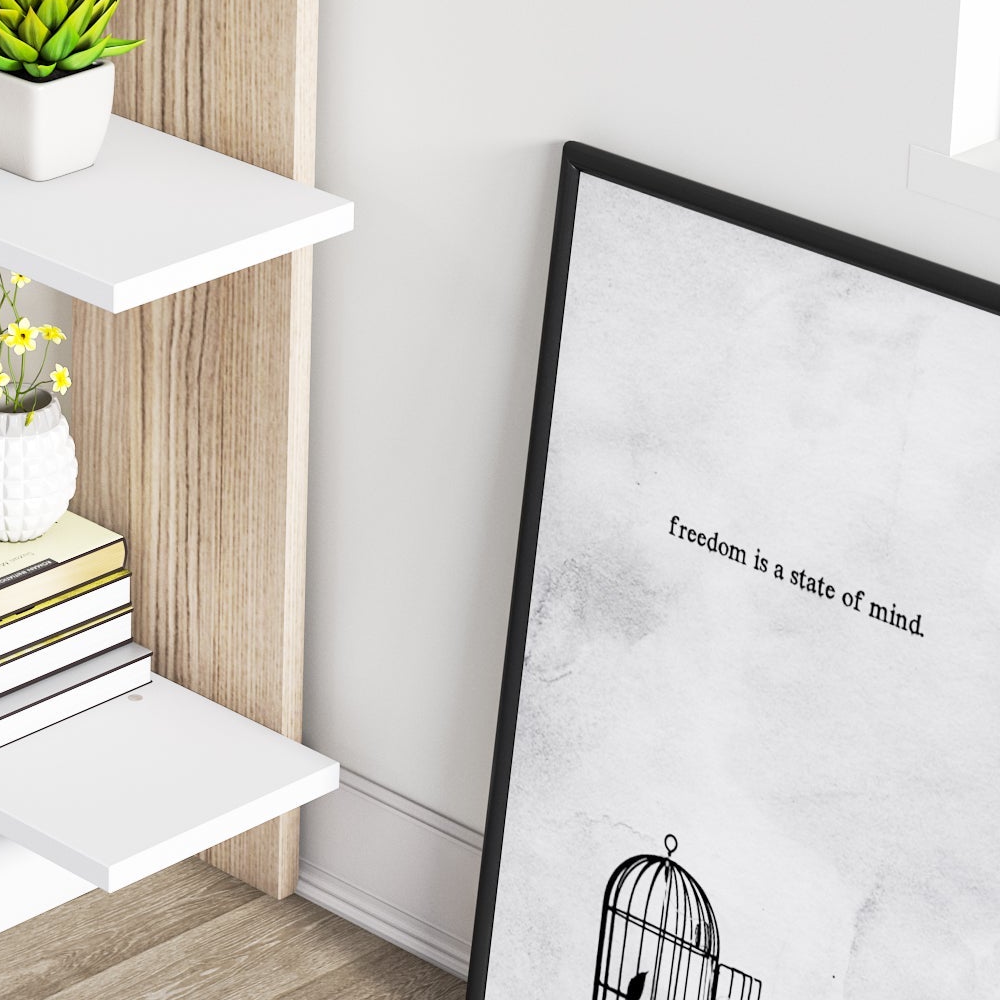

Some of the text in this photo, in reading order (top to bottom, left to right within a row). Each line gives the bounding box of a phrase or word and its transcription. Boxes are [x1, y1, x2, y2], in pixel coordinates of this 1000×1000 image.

[668, 515, 924, 638] freedom is a state of mind.
